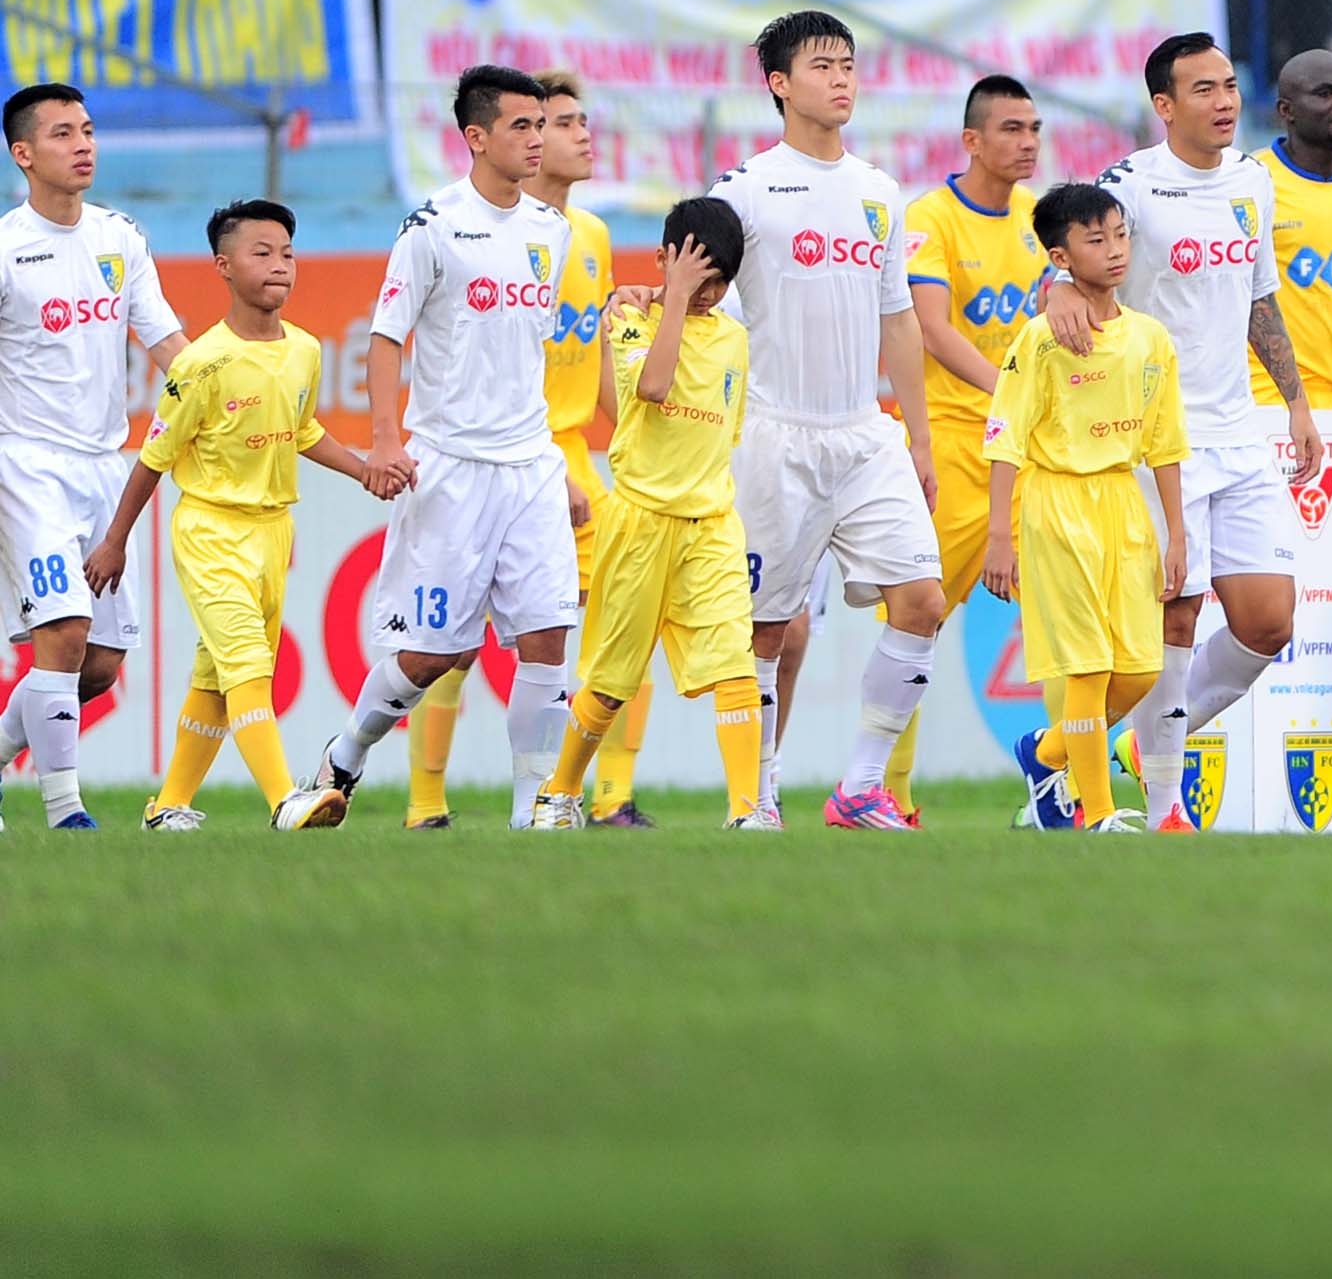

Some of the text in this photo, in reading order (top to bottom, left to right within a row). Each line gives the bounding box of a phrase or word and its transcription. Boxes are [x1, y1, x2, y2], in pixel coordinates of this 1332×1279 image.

[767, 185, 809, 194] Kappa
[1151, 188, 1188, 198] Kappa
[454, 231, 491, 241] Kappa
[16, 253, 55, 265] Kappa
[506, 283, 551, 308] SCG
[1082, 371, 1106, 383] SCG
[239, 395, 262, 408] SCG
[682, 407, 724, 426] TOYOTA
[29, 554, 69, 598] 88
[414, 585, 449, 630] 13
[1206, 756, 1220, 769] FC
[1291, 755, 1310, 768] HN
